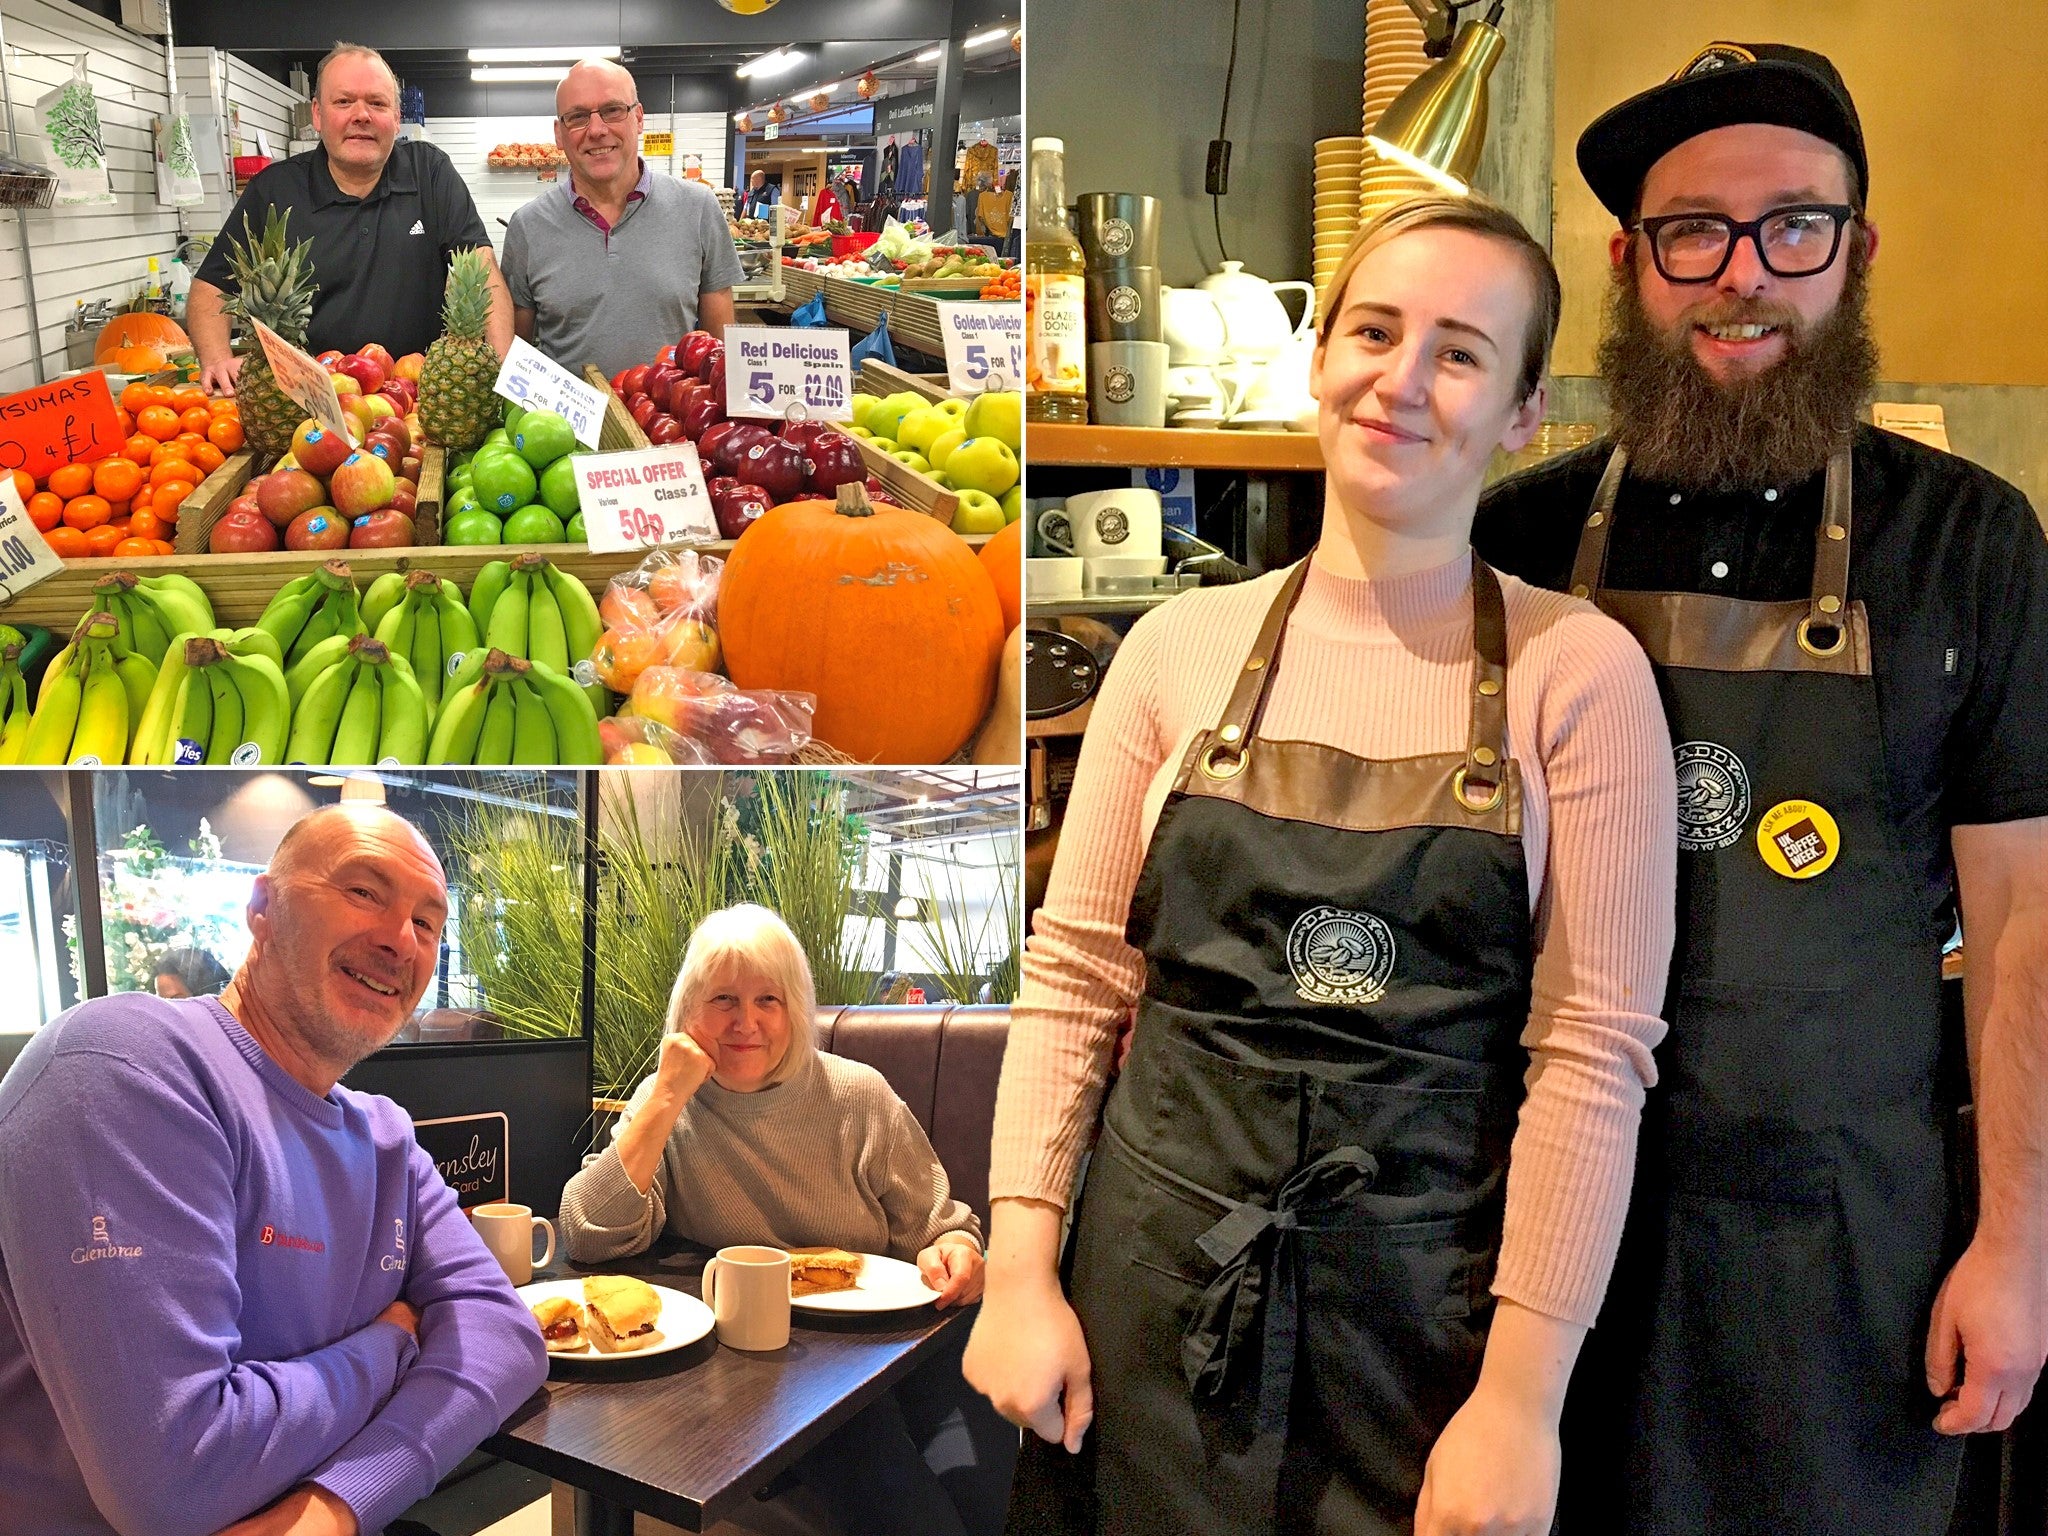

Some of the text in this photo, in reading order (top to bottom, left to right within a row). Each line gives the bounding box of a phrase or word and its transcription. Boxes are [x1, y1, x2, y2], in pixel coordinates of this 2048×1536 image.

[913, 103, 933, 114] Clothing
[793, 173, 817, 197] TOILETS
[953, 314, 987, 330] Golden
[1043, 310, 1077, 321] GLAZE
[1045, 321, 1077, 331] DONU
[741, 341, 839, 360] Red Delicious
[803, 360, 844, 369] Spain
[966, 345, 989, 380] 5
[991, 357, 1005, 368] FOR
[506, 374, 530, 399] 5
[533, 392, 549, 406] FOR
[748, 371, 844, 408] 5 FOR £2.00
[62, 415, 99, 463] £1
[586, 461, 687, 489] SPECIAL OFFER
[598, 498, 619, 507] Various
[654, 483, 698, 501] Class 2
[618, 507, 688, 543] 50p per
[1678, 745, 1741, 775] ADDY
[1763, 804, 1807, 834] ASK ME ABOUT
[1777, 832, 1794, 848] UK
[1783, 832, 1820, 858] COFFEE
[1302, 908, 1382, 931] DADDY
[1301, 971, 1378, 999] BEANZ
[451, 1178, 480, 1193] Card
[71, 1242, 143, 1264] Glenbrae
